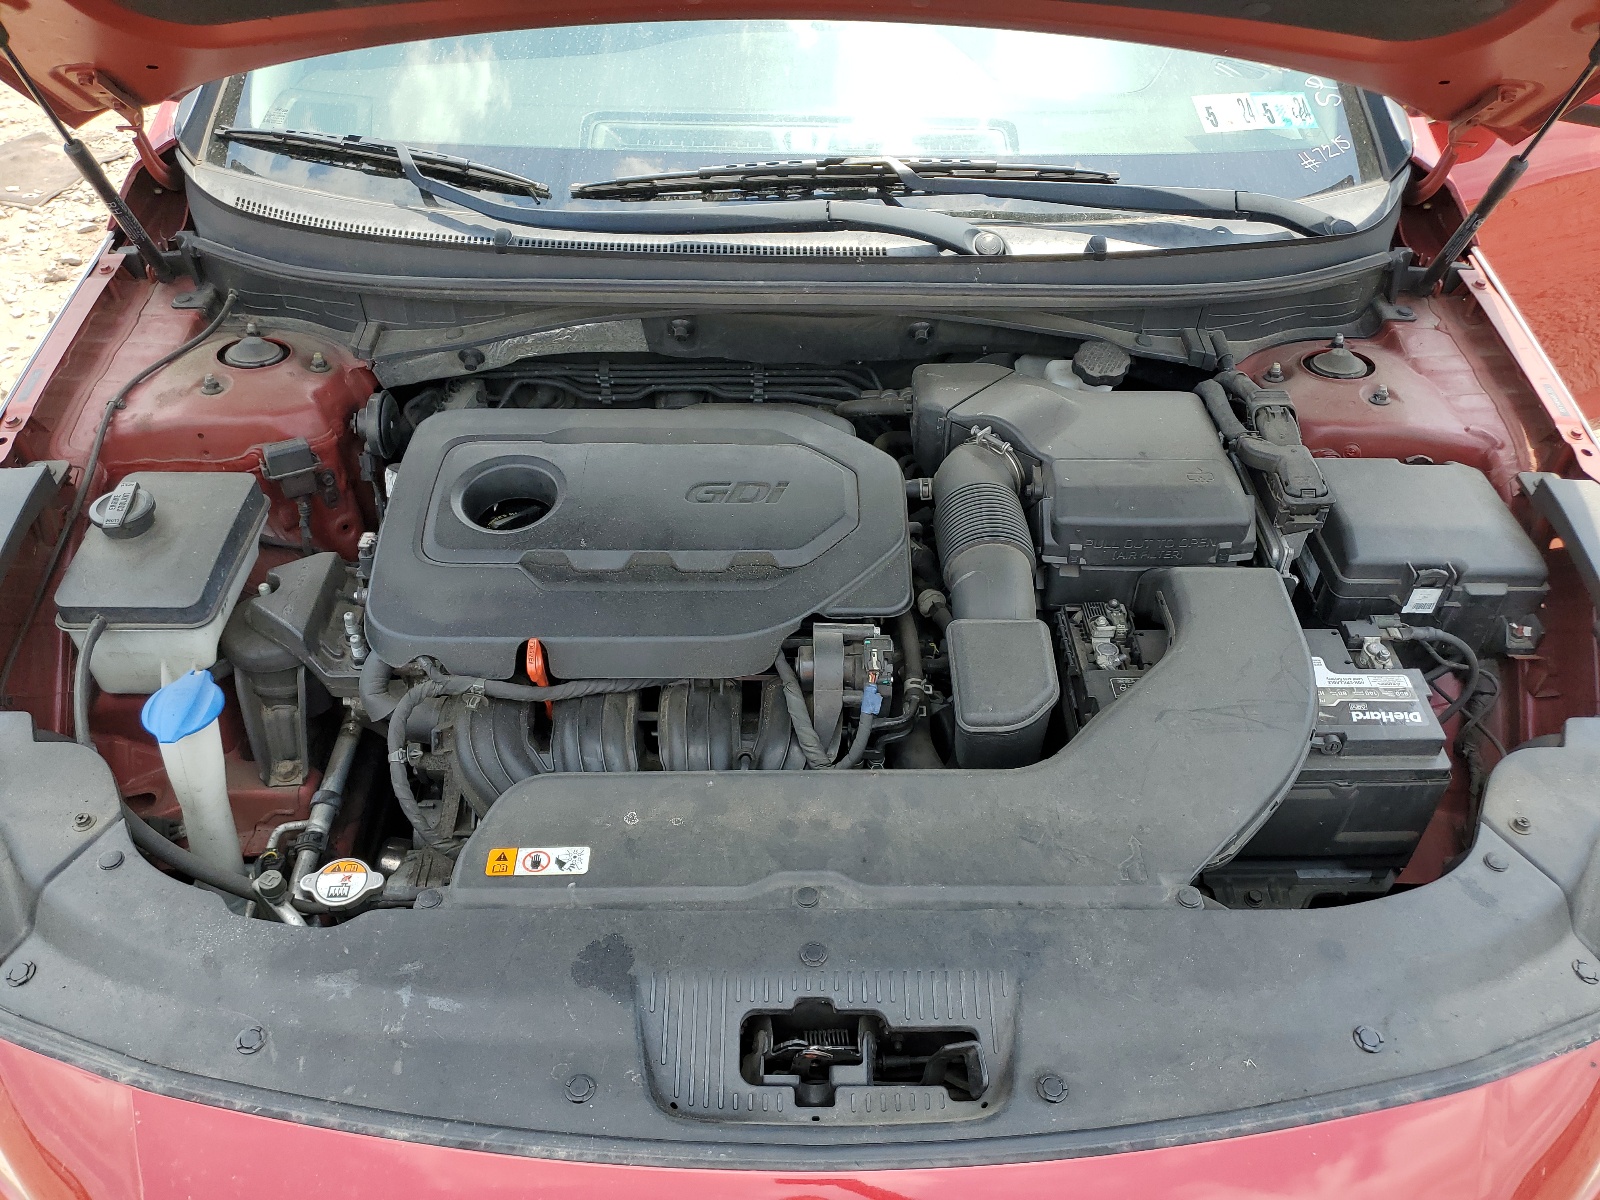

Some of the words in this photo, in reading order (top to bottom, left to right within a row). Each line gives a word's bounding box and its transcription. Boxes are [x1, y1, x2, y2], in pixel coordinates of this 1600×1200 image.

[1204, 105, 1219, 128] 5
[1236, 97, 1256, 124] 24
[1261, 102, 1276, 125] 5
[1083, 538, 1120, 549] PULL
[1123, 538, 1154, 549] OUT
[1157, 538, 1174, 549] TO
[1178, 537, 1218, 549] OPEN
[1351, 711, 1423, 723] DieHard
